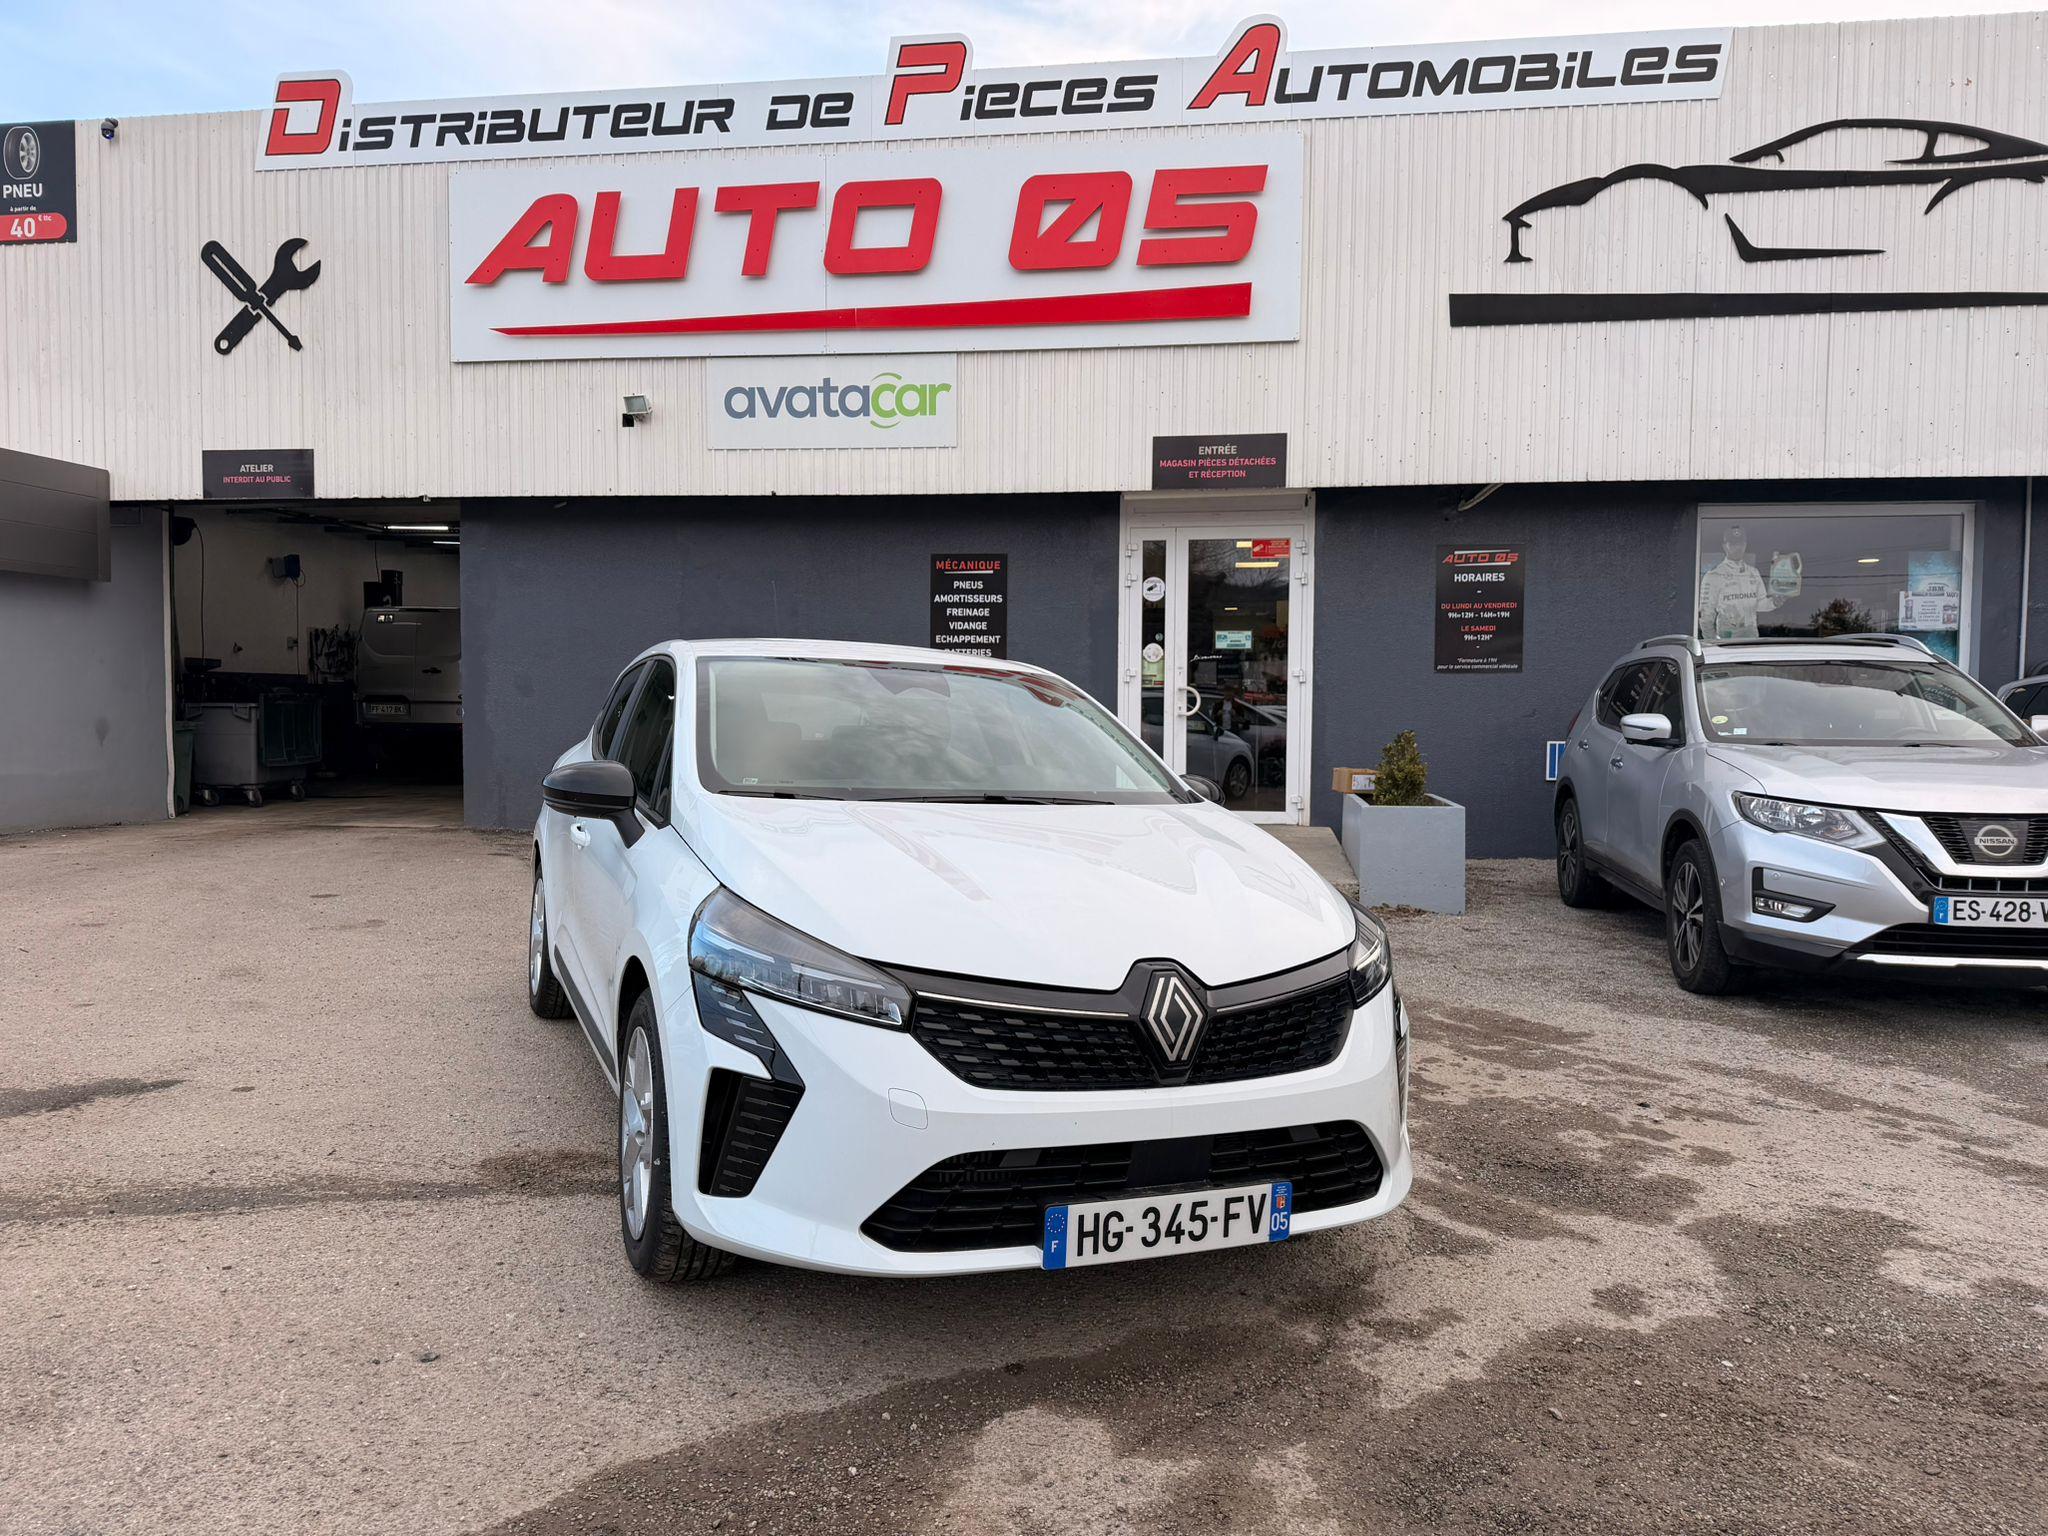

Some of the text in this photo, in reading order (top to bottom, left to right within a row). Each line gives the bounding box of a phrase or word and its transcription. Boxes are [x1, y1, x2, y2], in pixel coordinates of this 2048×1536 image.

[2, 183, 43, 198] PNEU
[10, 217, 36, 238] 40
[464, 178, 942, 285] AUTO
[724, 376, 952, 420] avatacar
[1198, 443, 1238, 455] ENTRÉE
[1160, 455, 1277, 468] MAGASIN PIÈCES DÉTACHÉES
[240, 464, 274, 473] ATELIER
[1188, 468, 1246, 479] ET RÉCEPTION
[223, 475, 291, 484] INTERDIT AU PUBLIC
[1442, 553, 1489, 563] AUTO
[935, 558, 1001, 570] MÉCANIQUE
[1454, 572, 1506, 582] HORAIRES
[953, 581, 984, 589] PNEUS
[934, 594, 1003, 603] AMORTISSEURS
[1723, 592, 1758, 602] PETRONAS
[946, 608, 990, 616] FREINAGE
[949, 622, 988, 630] VIDANGE
[936, 635, 1001, 644] ECHAPPEMENT
[944, 648, 992, 657] TTERIES
[1979, 837, 2015, 845] NISSAN
[1077, 1193, 1267, 1257] HG-345-FV
[1271, 1212, 1289, 1232] 05
[1051, 1241, 1059, 1253] F
